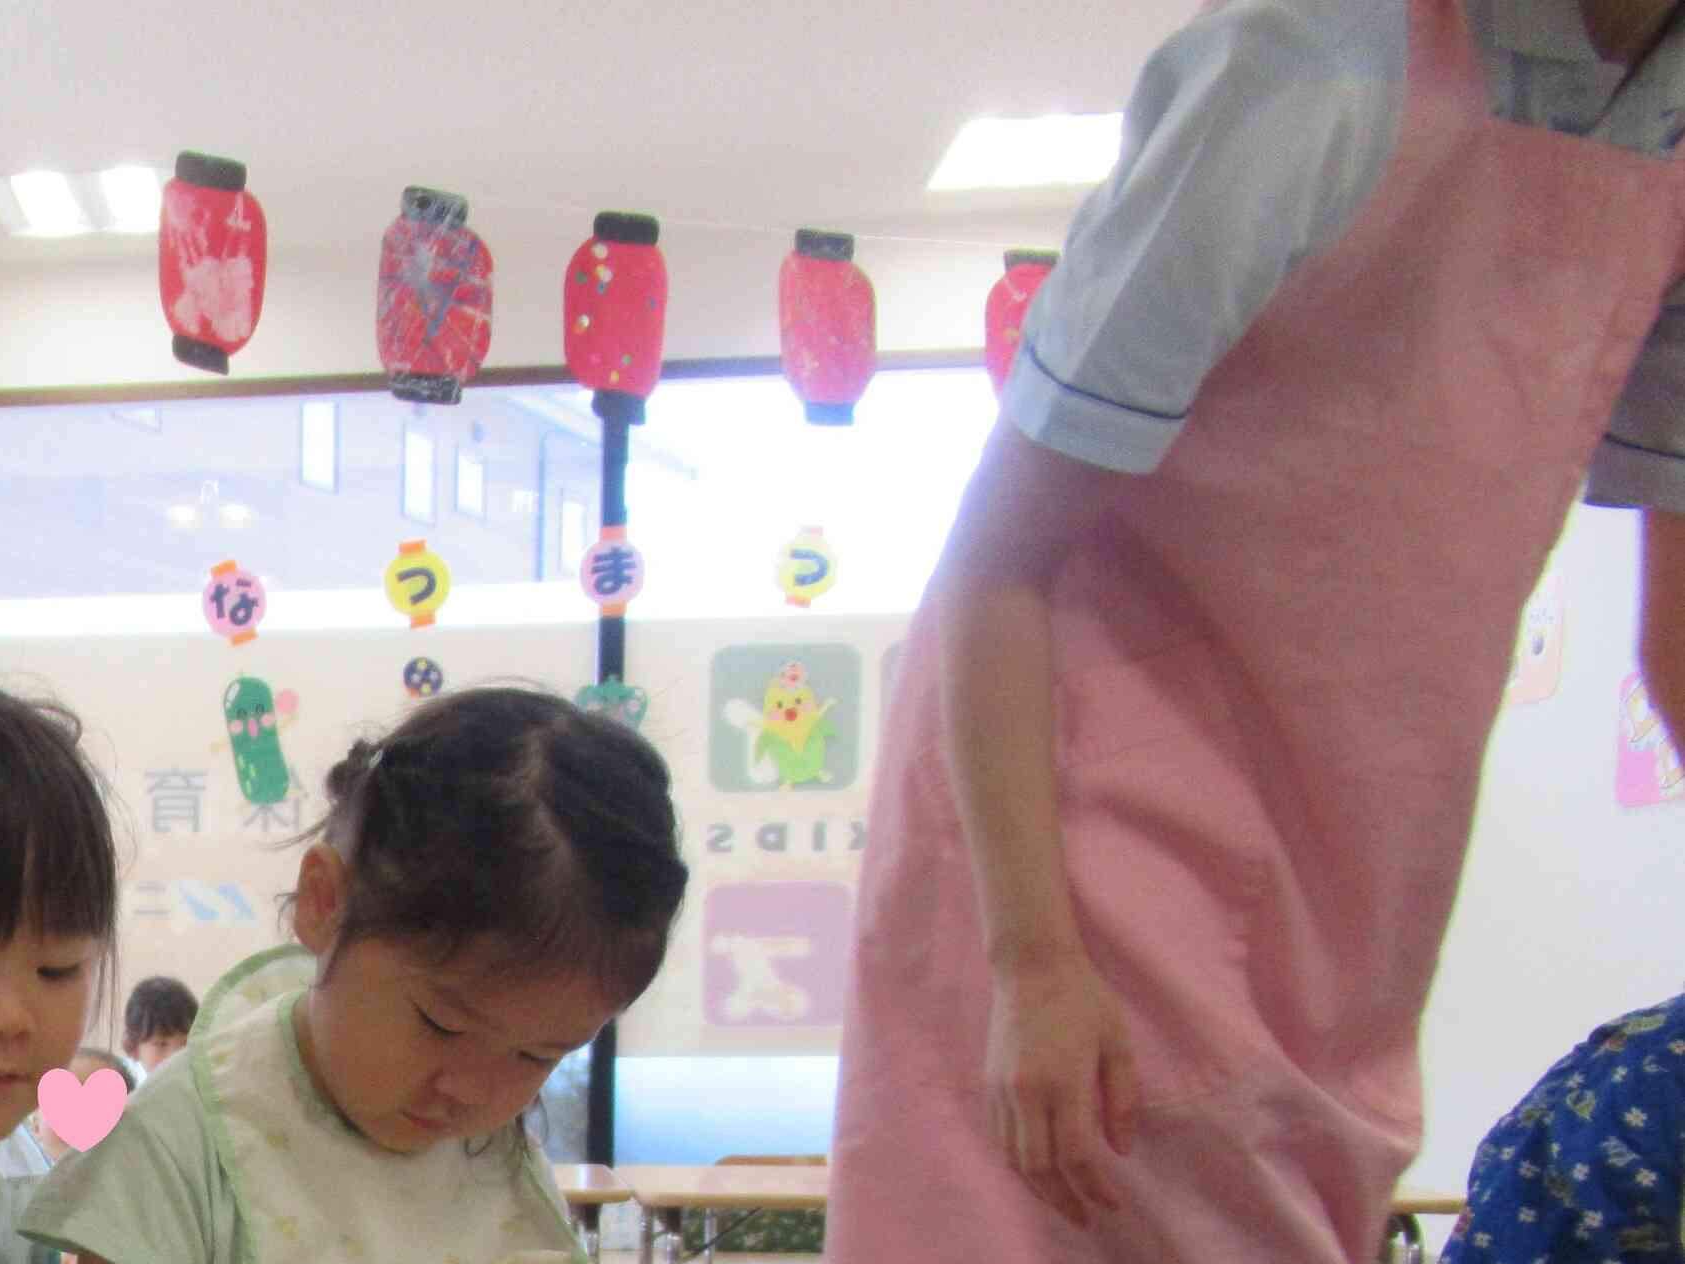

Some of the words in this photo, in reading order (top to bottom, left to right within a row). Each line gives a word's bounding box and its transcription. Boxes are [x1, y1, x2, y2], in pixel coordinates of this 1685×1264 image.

[209, 578, 259, 626] な
[396, 567, 436, 605] つ
[591, 546, 636, 595] ま
[790, 549, 829, 586] つ
